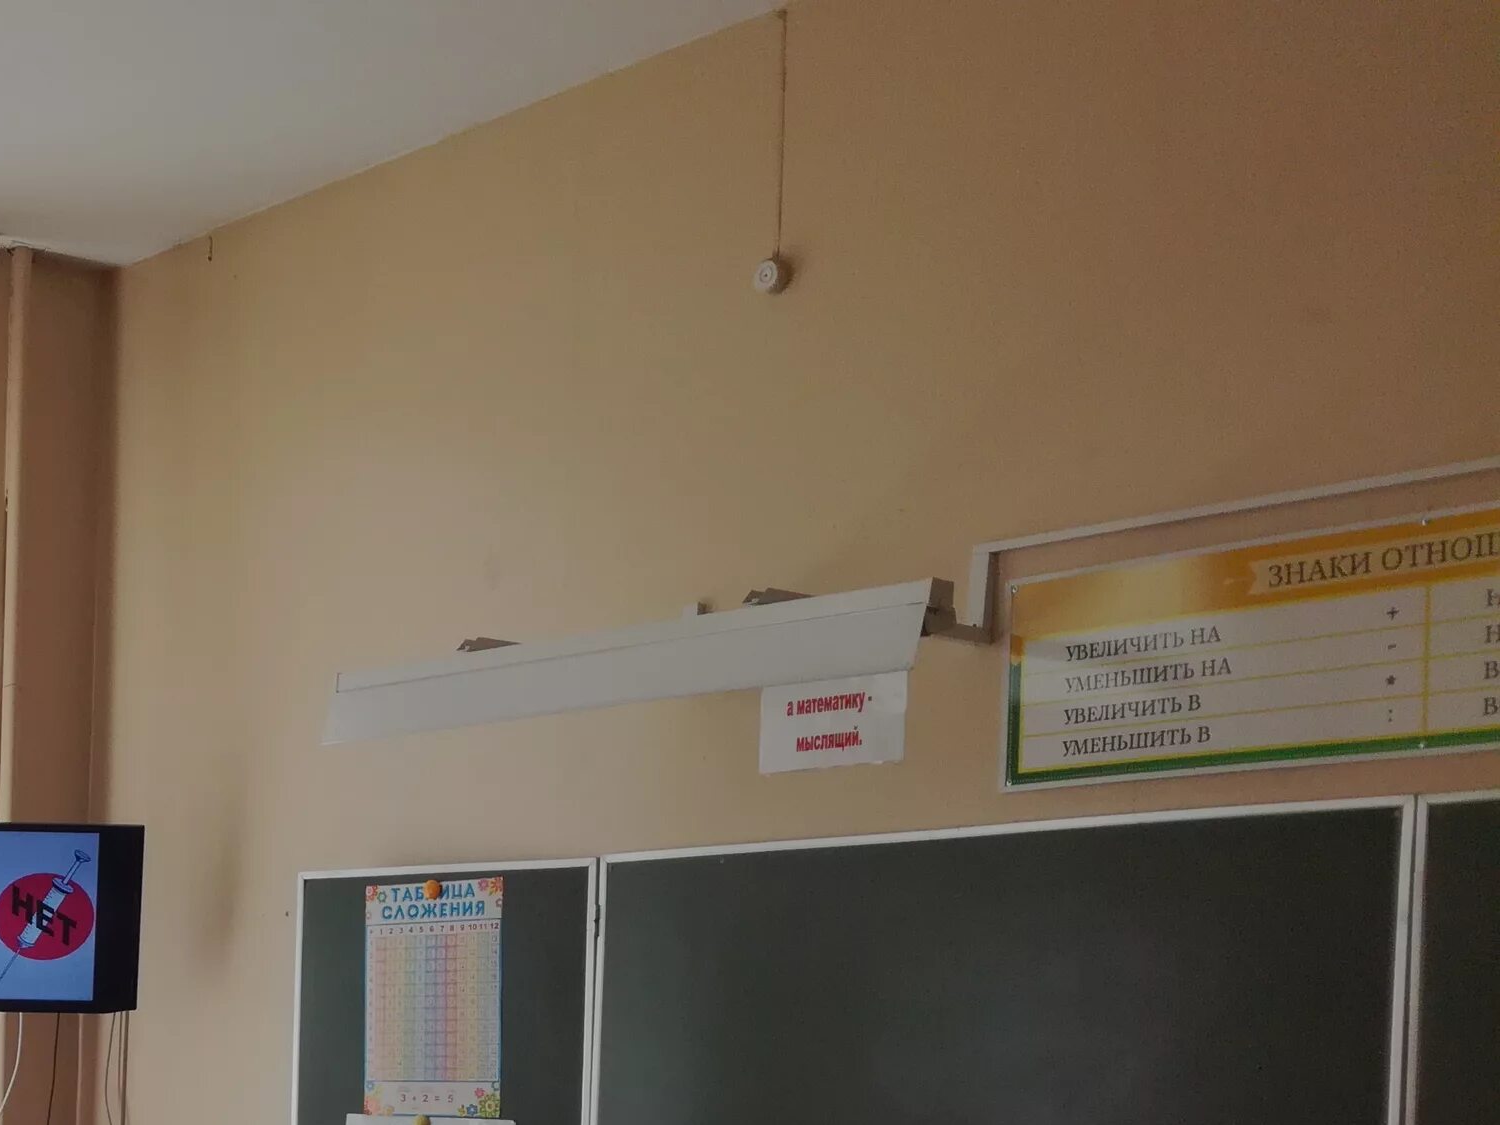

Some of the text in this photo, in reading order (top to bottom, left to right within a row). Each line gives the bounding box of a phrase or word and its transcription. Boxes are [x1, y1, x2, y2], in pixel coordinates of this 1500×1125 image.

[1268, 551, 1371, 588] ЗНАКИ
[1065, 630, 1183, 661] УВЕЛИЧИТЬ
[1190, 627, 1222, 645] НА
[1064, 664, 1194, 694] УМЕНЬШИТЬ
[1200, 659, 1232, 677] НА
[786, 700, 794, 716] а
[797, 691, 865, 716] математику
[1063, 696, 1182, 726] УВЕЛИЧИТЬ
[1188, 694, 1201, 711] В
[1062, 730, 1191, 758] УМЕНЬШИТЬ
[1198, 726, 1211, 743] В
[391, 883, 476, 902] ТАБИЦА
[11, 884, 77, 946] НЕТ
[382, 901, 485, 920] СЛОЖЕНИЯ
[490, 922, 500, 930] 12
[400, 1094, 406, 1102] 3
[423, 1094, 428, 1102] 2
[448, 1094, 453, 1103] 5
